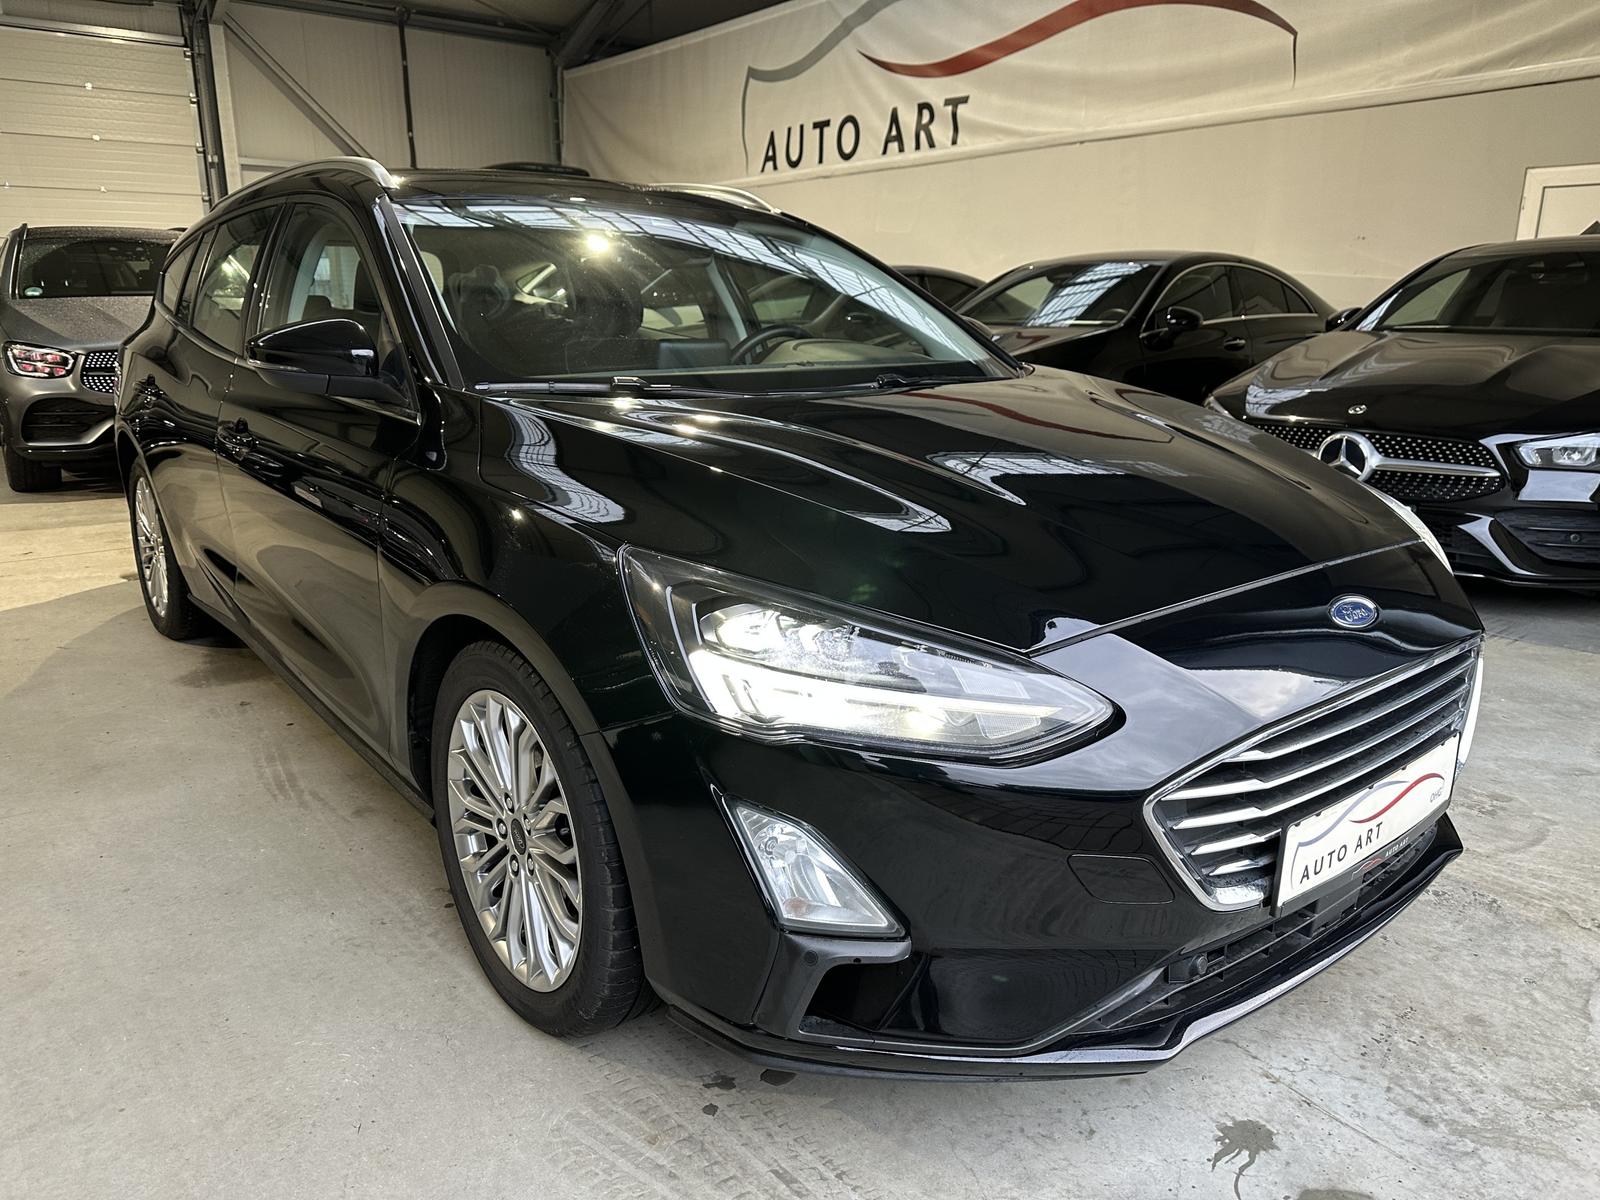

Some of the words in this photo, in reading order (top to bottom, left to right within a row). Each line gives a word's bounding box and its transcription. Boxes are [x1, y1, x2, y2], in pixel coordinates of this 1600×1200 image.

[760, 114, 861, 174] AUTO
[881, 95, 971, 156] ART
[1300, 844, 1348, 885] AUTO
[1354, 821, 1383, 854] ART
